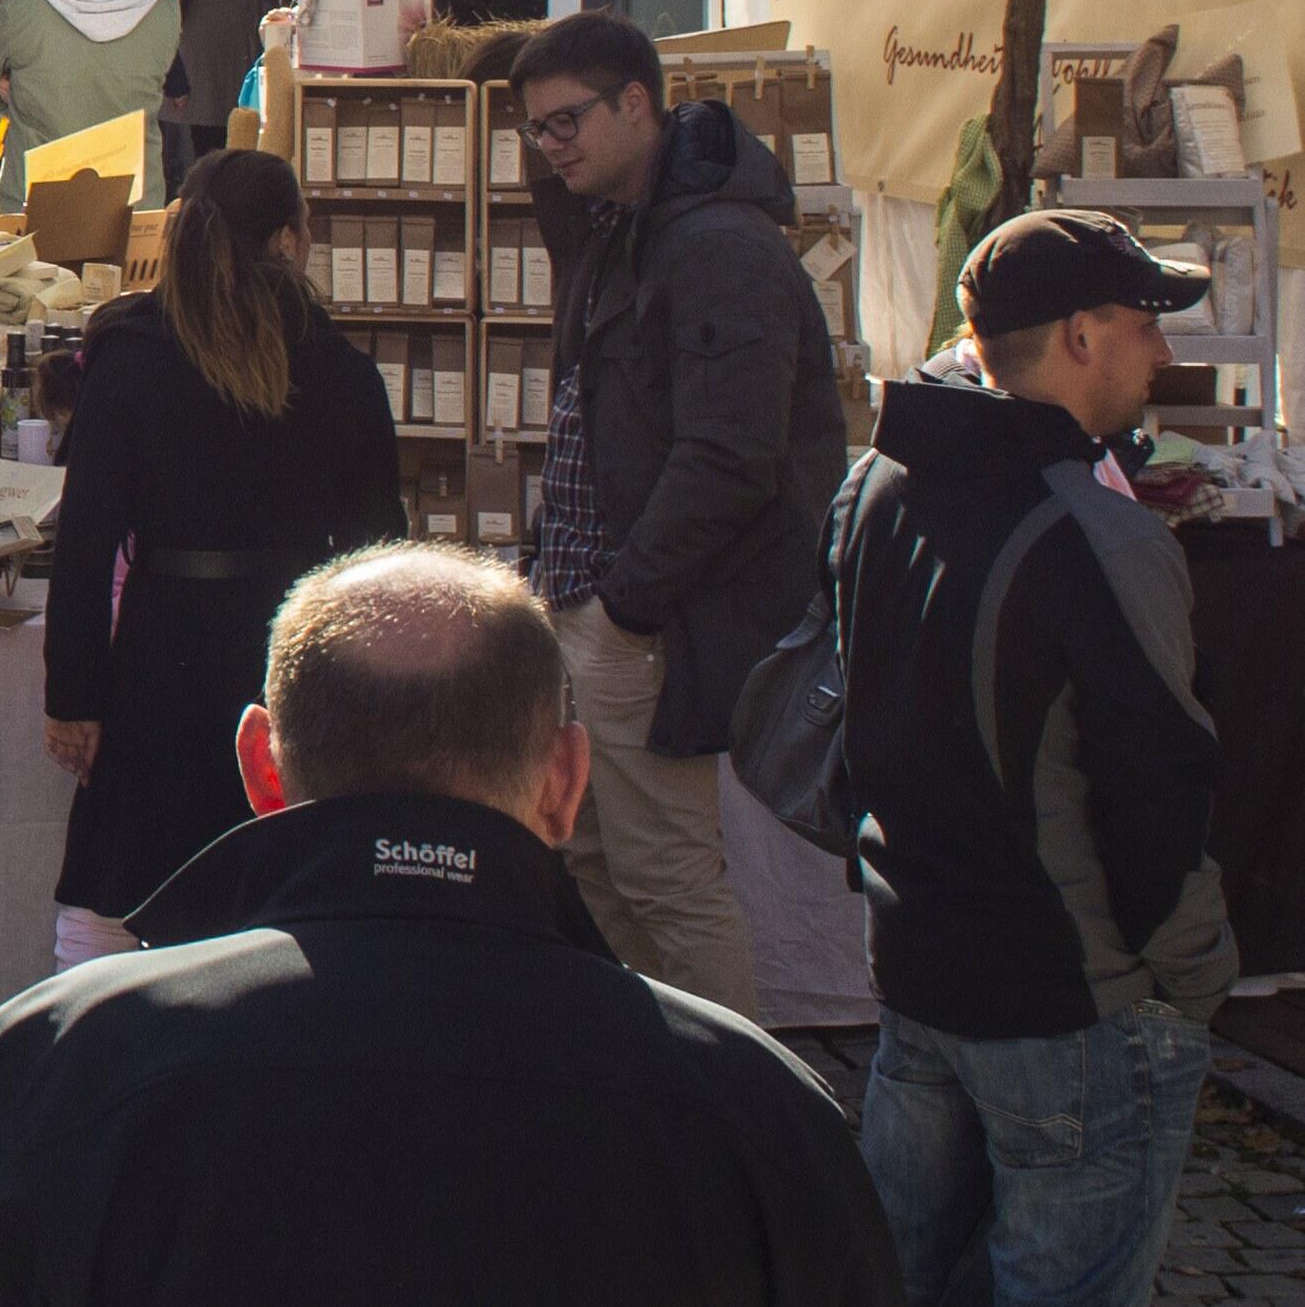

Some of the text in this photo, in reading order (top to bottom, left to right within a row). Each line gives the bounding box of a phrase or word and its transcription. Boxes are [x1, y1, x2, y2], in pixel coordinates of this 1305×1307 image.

[375, 838, 477, 870] Schöffel
[373, 862, 476, 884] professional wear
